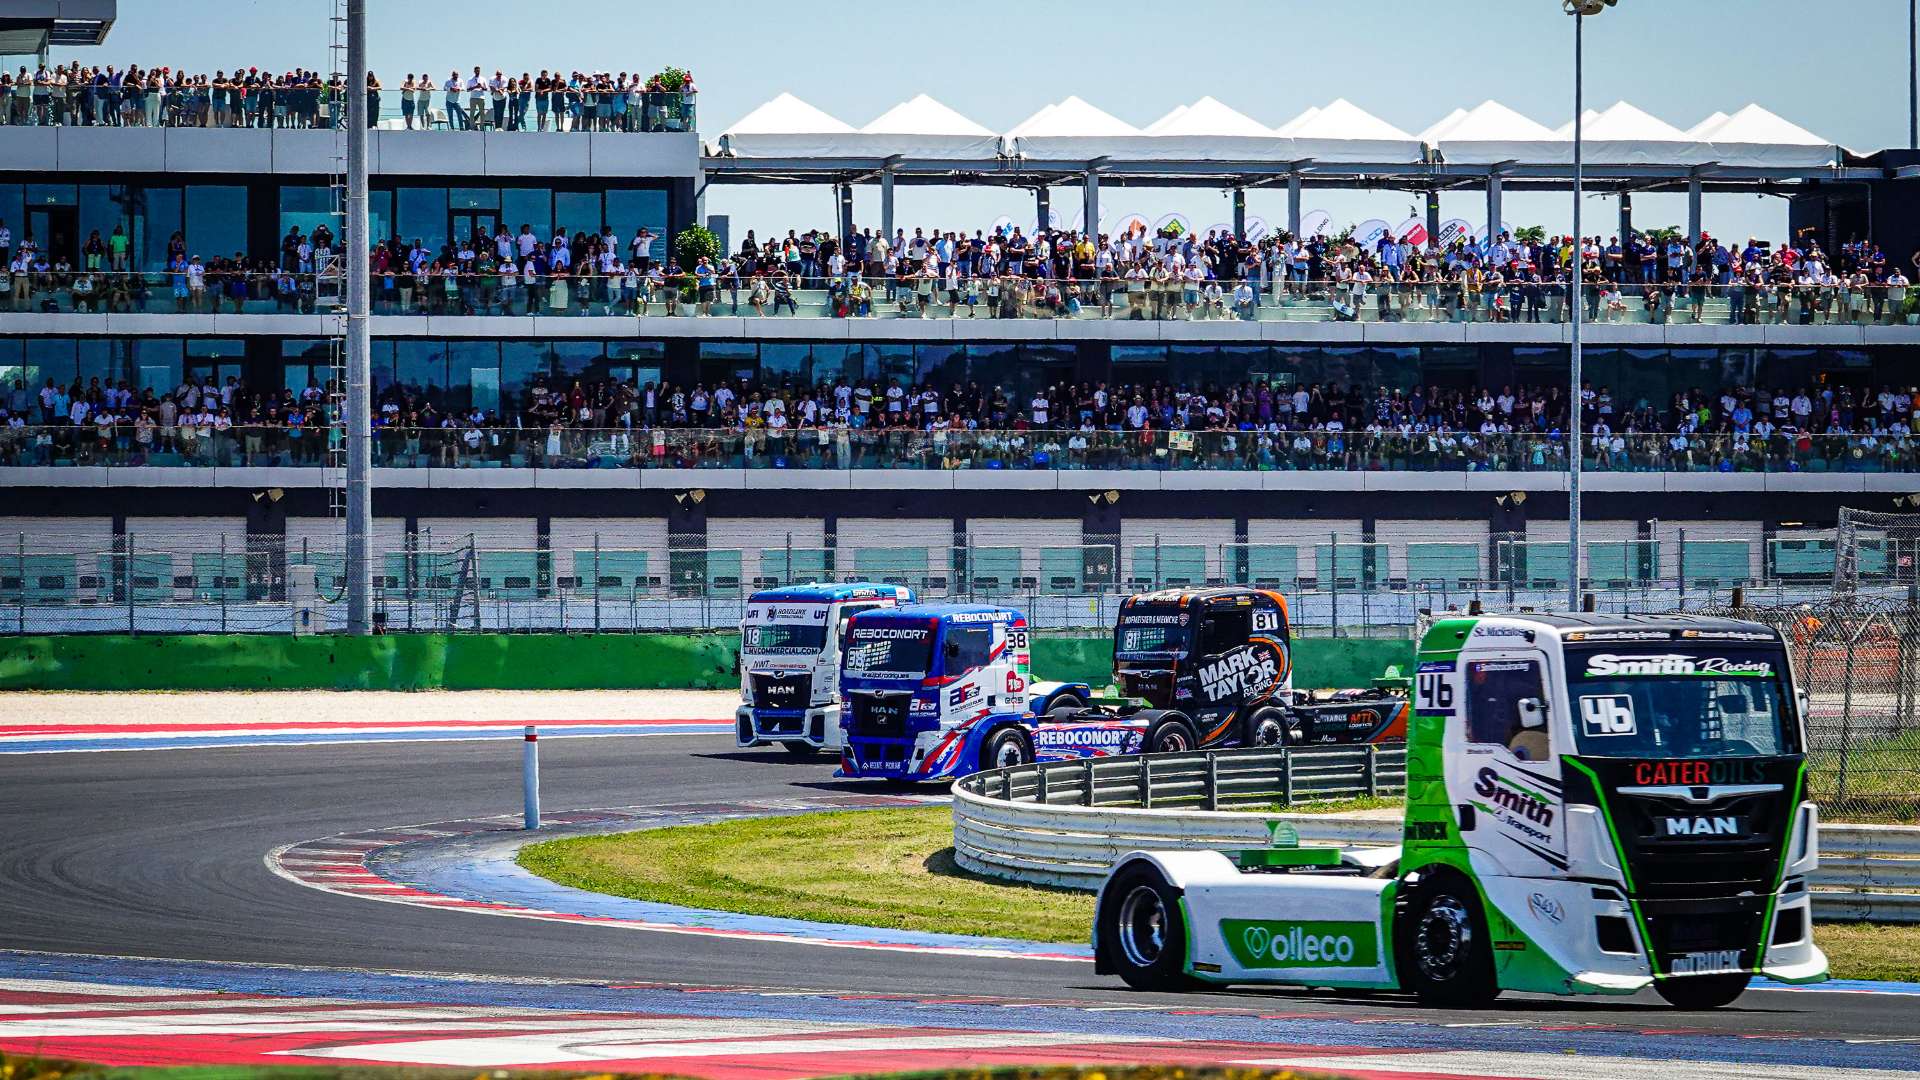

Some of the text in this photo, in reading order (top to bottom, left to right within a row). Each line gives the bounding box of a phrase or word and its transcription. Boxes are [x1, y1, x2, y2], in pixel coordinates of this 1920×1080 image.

[747, 609, 759, 619] UFI
[952, 611, 1013, 623] REBOCONORT
[1255, 613, 1278, 630] 81
[747, 628, 760, 645] 18
[1007, 633, 1026, 649] 38
[1125, 632, 1137, 649] 81
[847, 650, 865, 669] 38
[1198, 646, 1259, 687] MARK
[1586, 654, 1771, 677] Smith Racing
[767, 685, 795, 695] MAN
[1203, 659, 1278, 702] TAYLOR
[1242, 678, 1273, 698] RACING
[1419, 673, 1453, 708] 46
[870, 706, 898, 715] MAN
[1583, 698, 1633, 733] 46
[1635, 761, 1765, 785] CATEROILS
[1473, 766, 1554, 828] Smith
[1505, 815, 1553, 844] Transport
[1666, 817, 1738, 835] MAN
[1271, 926, 1354, 962] oileco
